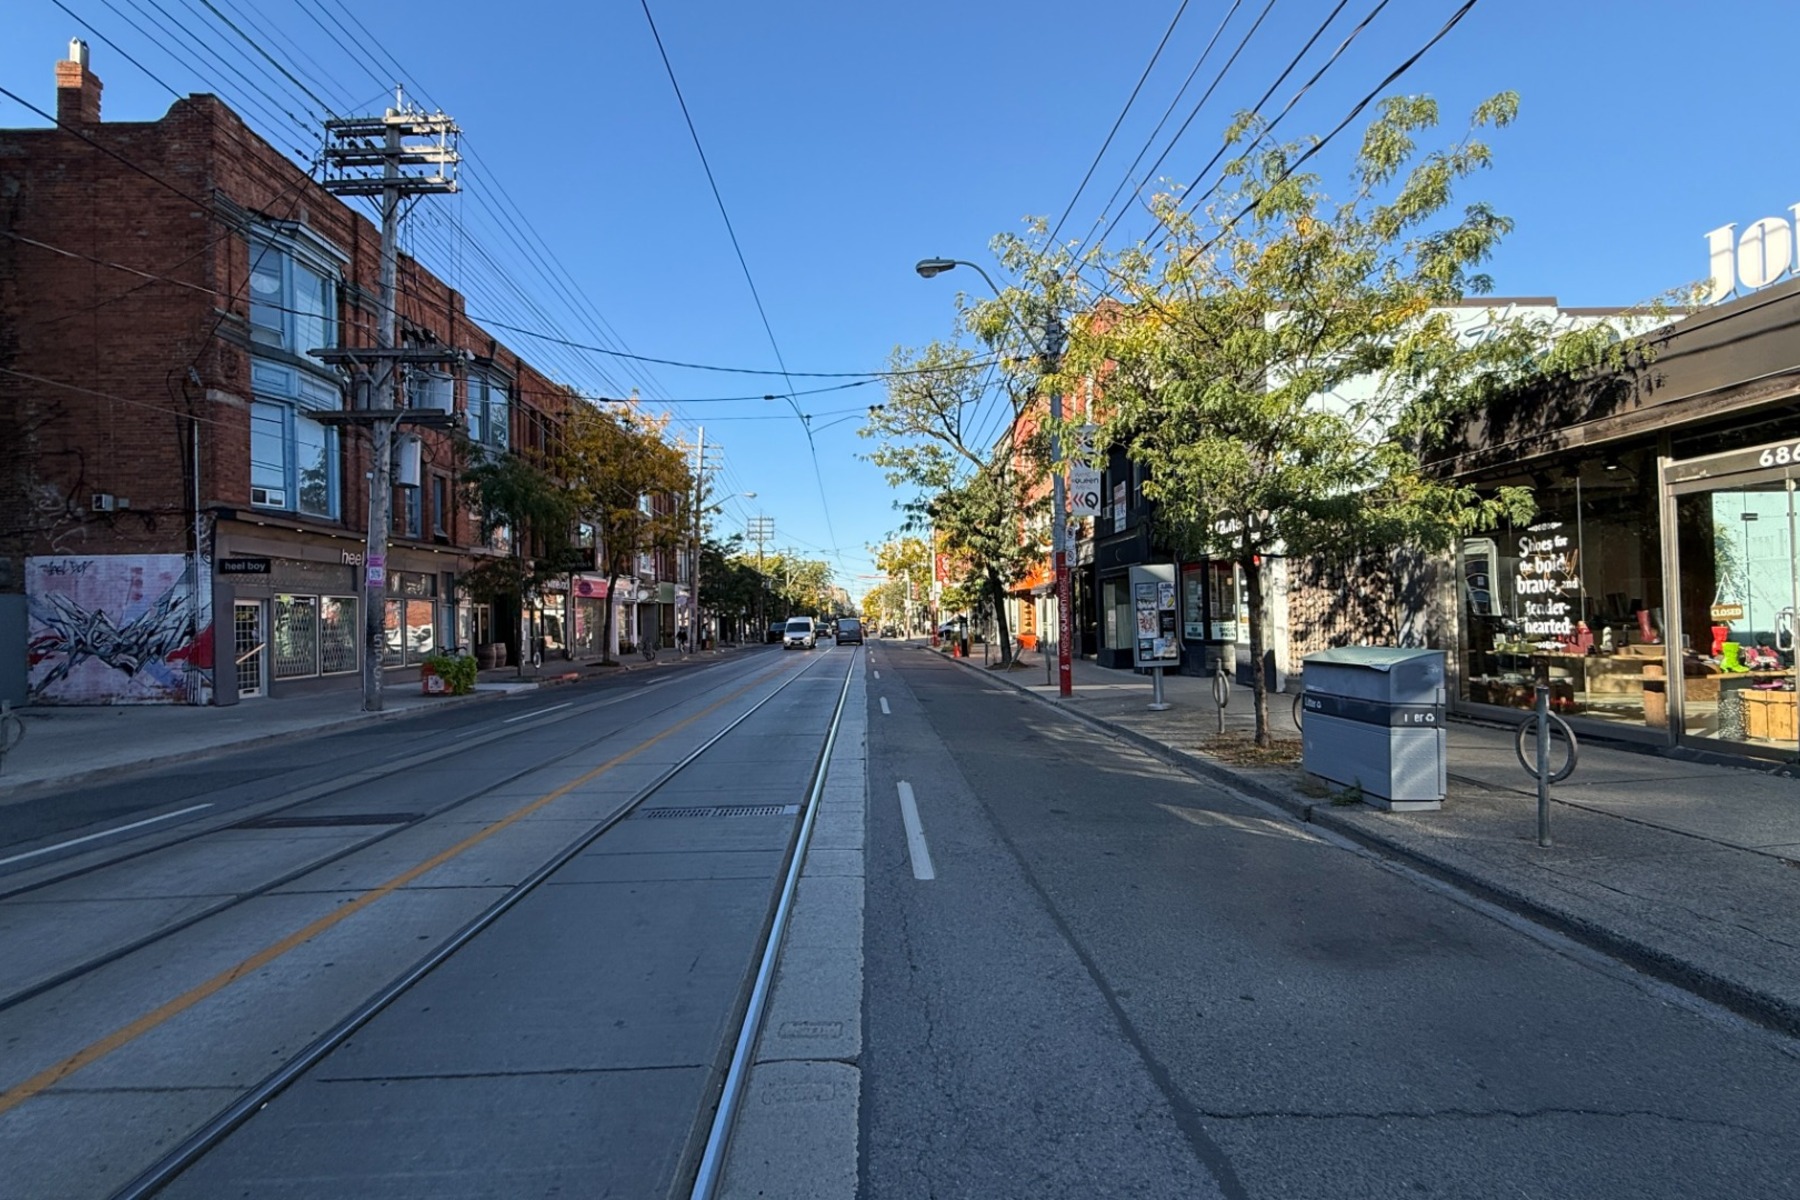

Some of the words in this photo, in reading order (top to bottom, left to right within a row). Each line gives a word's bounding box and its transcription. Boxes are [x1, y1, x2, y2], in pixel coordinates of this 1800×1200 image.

[1692, 202, 1800, 306] JO
[1518, 536, 1553, 558] Shoes
[1554, 535, 1568, 547] for
[225, 561, 245, 570] heel
[247, 561, 266, 572] boy
[341, 548, 365, 567] heel
[1519, 560, 1534, 572] the
[1516, 574, 1561, 596] brave,
[1561, 575, 1579, 589] and
[1524, 598, 1571, 615] tender-
[1711, 607, 1742, 617] CLOSED
